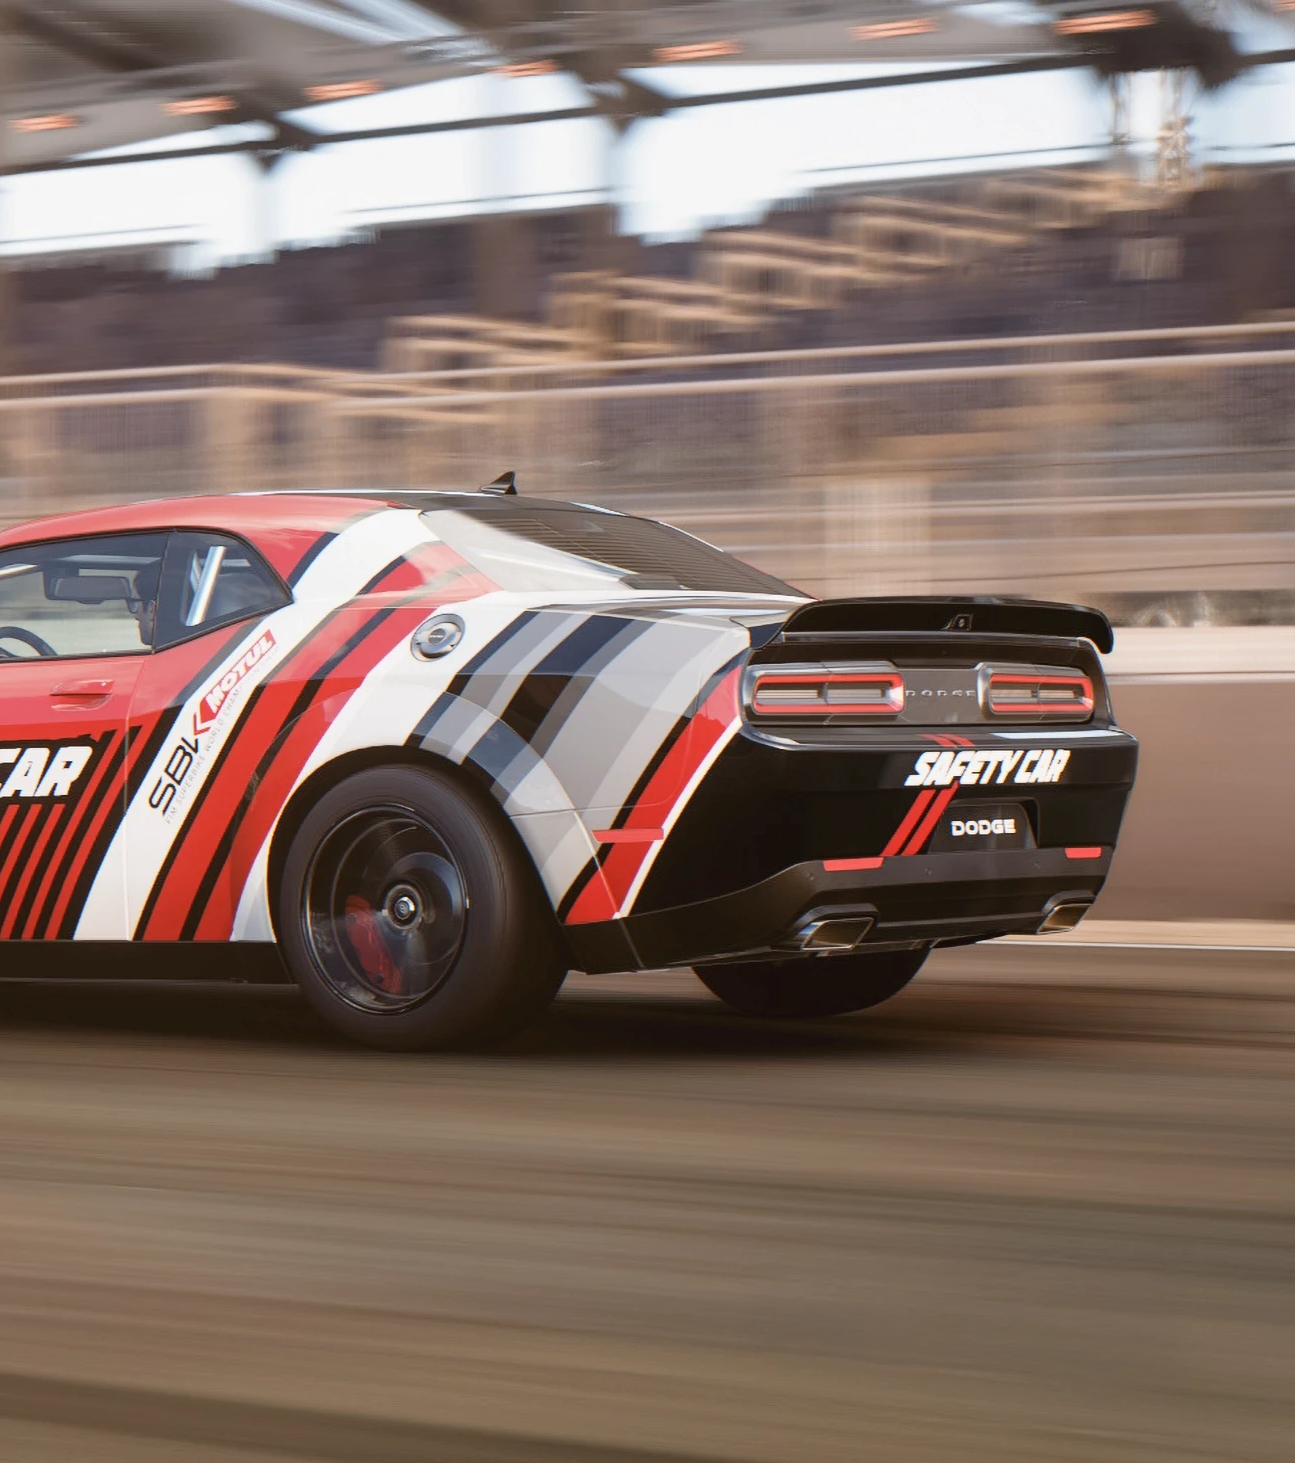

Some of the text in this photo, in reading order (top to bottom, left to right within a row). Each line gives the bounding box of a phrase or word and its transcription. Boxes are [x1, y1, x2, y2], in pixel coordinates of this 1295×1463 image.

[204, 634, 275, 715] MOTUL
[205, 717, 225, 752] WORLD
[904, 749, 1071, 786] SAFETY CAR
[951, 819, 1016, 836] DODGE
